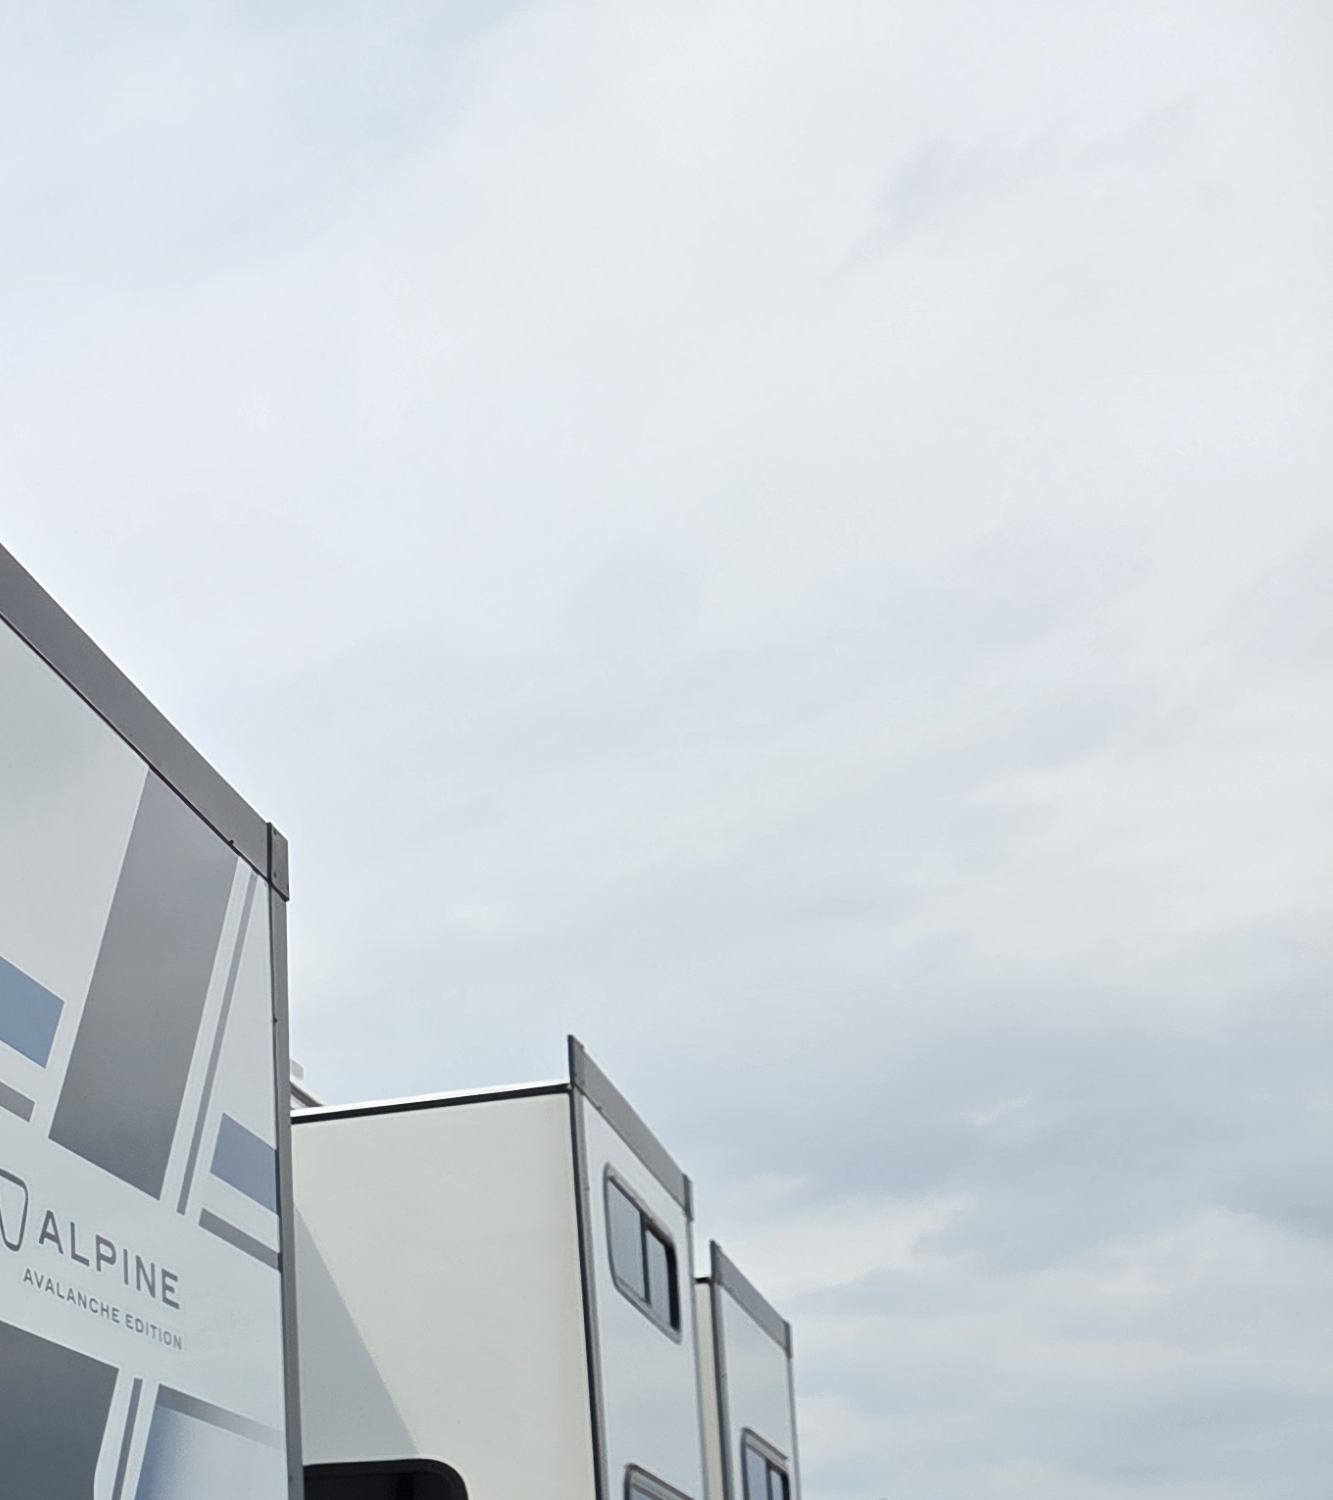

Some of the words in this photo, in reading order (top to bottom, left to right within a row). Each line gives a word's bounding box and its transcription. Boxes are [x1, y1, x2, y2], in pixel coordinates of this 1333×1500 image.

[37, 1209, 181, 1311] ALPINE
[22, 1267, 121, 1324] AVALANCHE
[124, 1313, 183, 1351] EDITION
